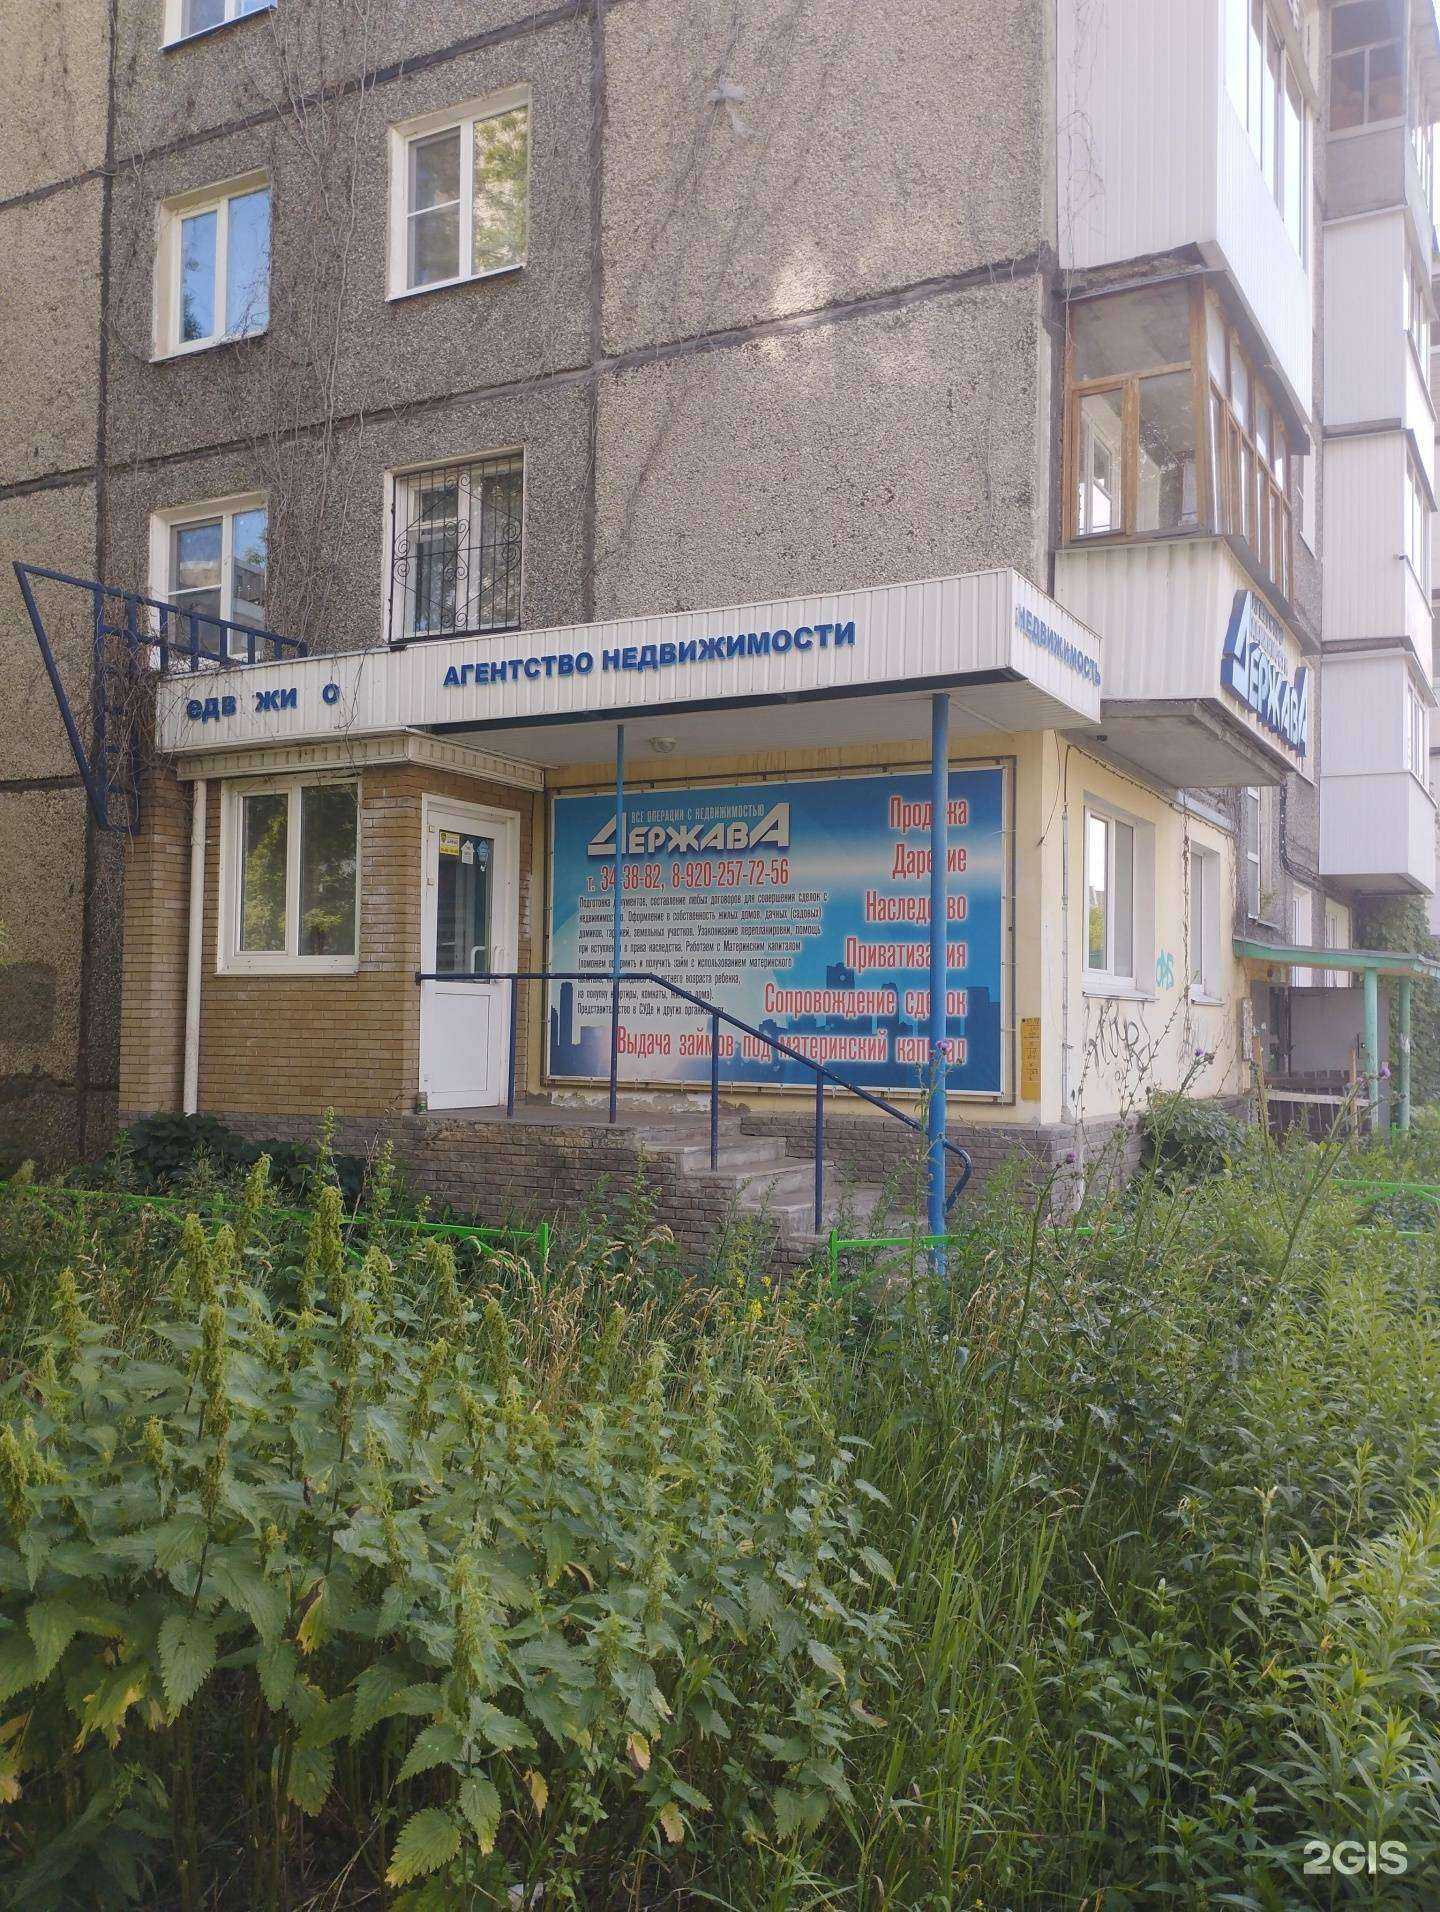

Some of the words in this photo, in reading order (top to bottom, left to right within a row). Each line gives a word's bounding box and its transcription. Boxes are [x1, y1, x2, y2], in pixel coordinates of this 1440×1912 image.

[443, 651, 594, 687] АГЕНТСТВО
[602, 621, 857, 672] НЕДВИЖИМОСТИ
[1015, 605, 1101, 687] НЕДВИЖИМОСТЬ
[1222, 590, 1309, 757] ДЕРЖАВА
[587, 802, 791, 856] ДЕРЖАВА
[631, 812, 645, 824] ВСЕ
[647, 809, 684, 824] ОПЕРАЦИИ
[687, 811, 693, 820] С
[695, 803, 765, 821] НЕДВИЖИМОСТЬЮ
[889, 796, 968, 833] Проджа
[601, 863, 666, 896] 3438-82,
[671, 857, 789, 889] 8-920-257-72-56
[892, 843, 967, 880] Дарие
[579, 896, 611, 909] Подготовка
[650, 896, 686, 907] составление
[688, 893, 708, 905] любых
[710, 895, 742, 906] договоров
[744, 894, 757, 906] для
[758, 893, 796, 905] совершения
[798, 892, 821, 904] сделок
[628, 910, 664, 923] Оформление
[666, 914, 671, 922] в
[673, 909, 716, 921] собственность
[718, 910, 738, 920] жилых
[764, 909, 788, 920] дачных
[790, 907, 822, 920] (садовых)
[866, 890, 967, 925] Наследво
[578, 945, 589, 955] при
[629, 943, 647, 954] права
[685, 940, 714, 953] Работаем
[716, 942, 721, 951] с
[723, 941, 765, 953] Материнским
[767, 940, 801, 952] капиталом
[633, 927, 665, 938] земельных
[697, 924, 739, 936] Узаконивание
[795, 924, 821, 936] помощь
[645, 958, 672, 970] получить
[697, 957, 747, 969] использованием
[749, 957, 793, 969] материнского
[846, 937, 967, 973] Приватизаия
[685, 973, 712, 985] возраста
[577, 1002, 630, 1017] Представитество
[632, 1005, 637, 1015] в
[656, 1005, 661, 1014] и
[662, 1005, 682, 1017] других
[764, 982, 897, 1018] Сопровождение
[905, 989, 967, 1019] сдеок
[617, 1025, 671, 1059] Выдача
[897, 1036, 967, 1065] капал
